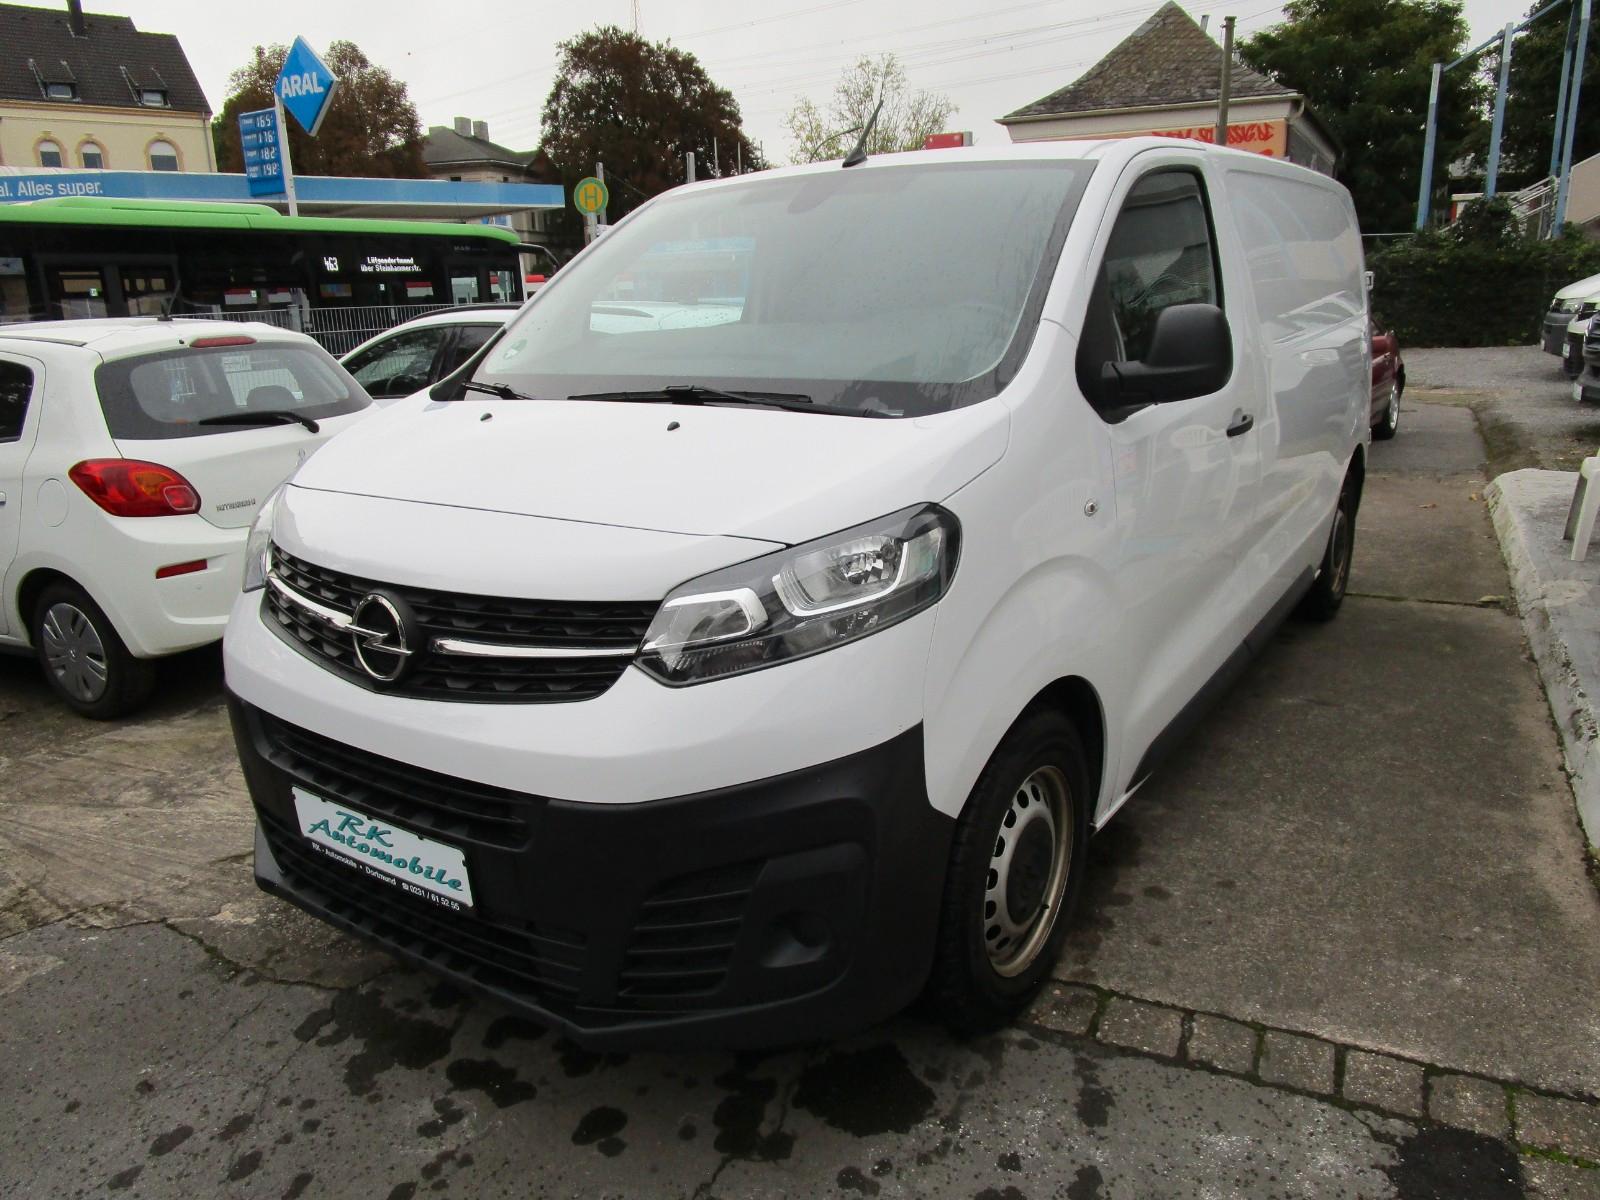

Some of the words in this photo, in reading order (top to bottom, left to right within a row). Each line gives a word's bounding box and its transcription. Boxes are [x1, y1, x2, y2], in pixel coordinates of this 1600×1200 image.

[281, 71, 324, 98] ARAL
[17, 180, 54, 196] Alles
[58, 181, 103, 195] super.
[323, 256, 339, 272] 463
[336, 810, 394, 848] RK
[308, 818, 463, 892] Automobile
[325, 848, 358, 869] Automobile
[365, 866, 397, 886] Dortmund
[409, 885, 426, 898] 0231
